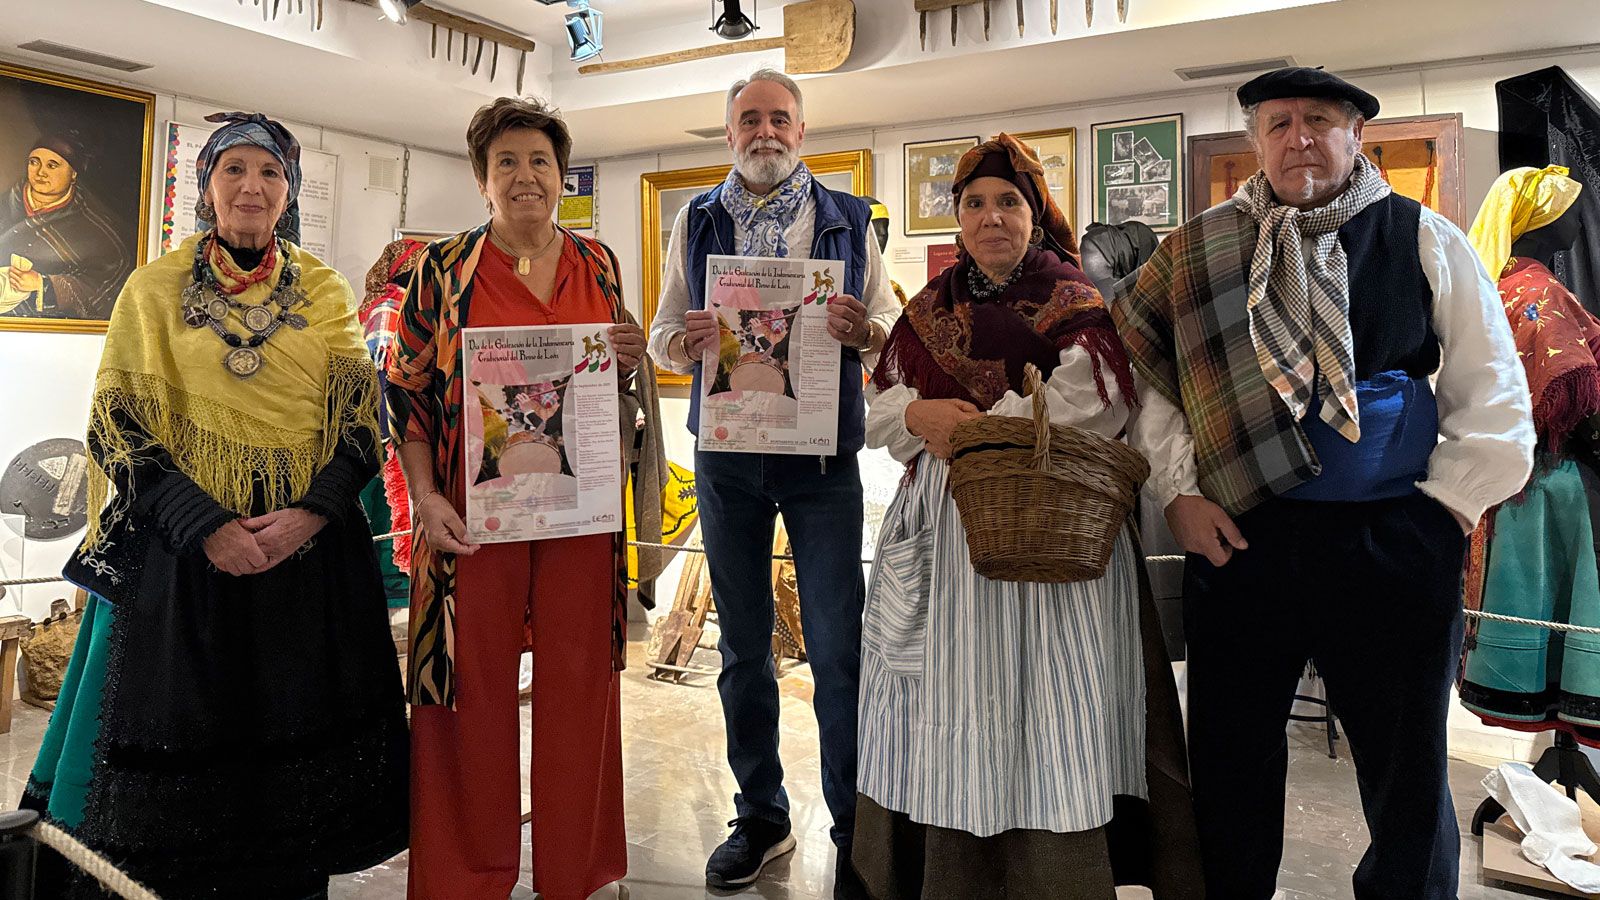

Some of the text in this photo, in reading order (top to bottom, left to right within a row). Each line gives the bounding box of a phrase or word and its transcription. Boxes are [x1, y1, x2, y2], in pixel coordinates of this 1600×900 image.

[481, 339, 488, 350] de
[526, 337, 532, 348] de
[537, 350, 543, 360] de
